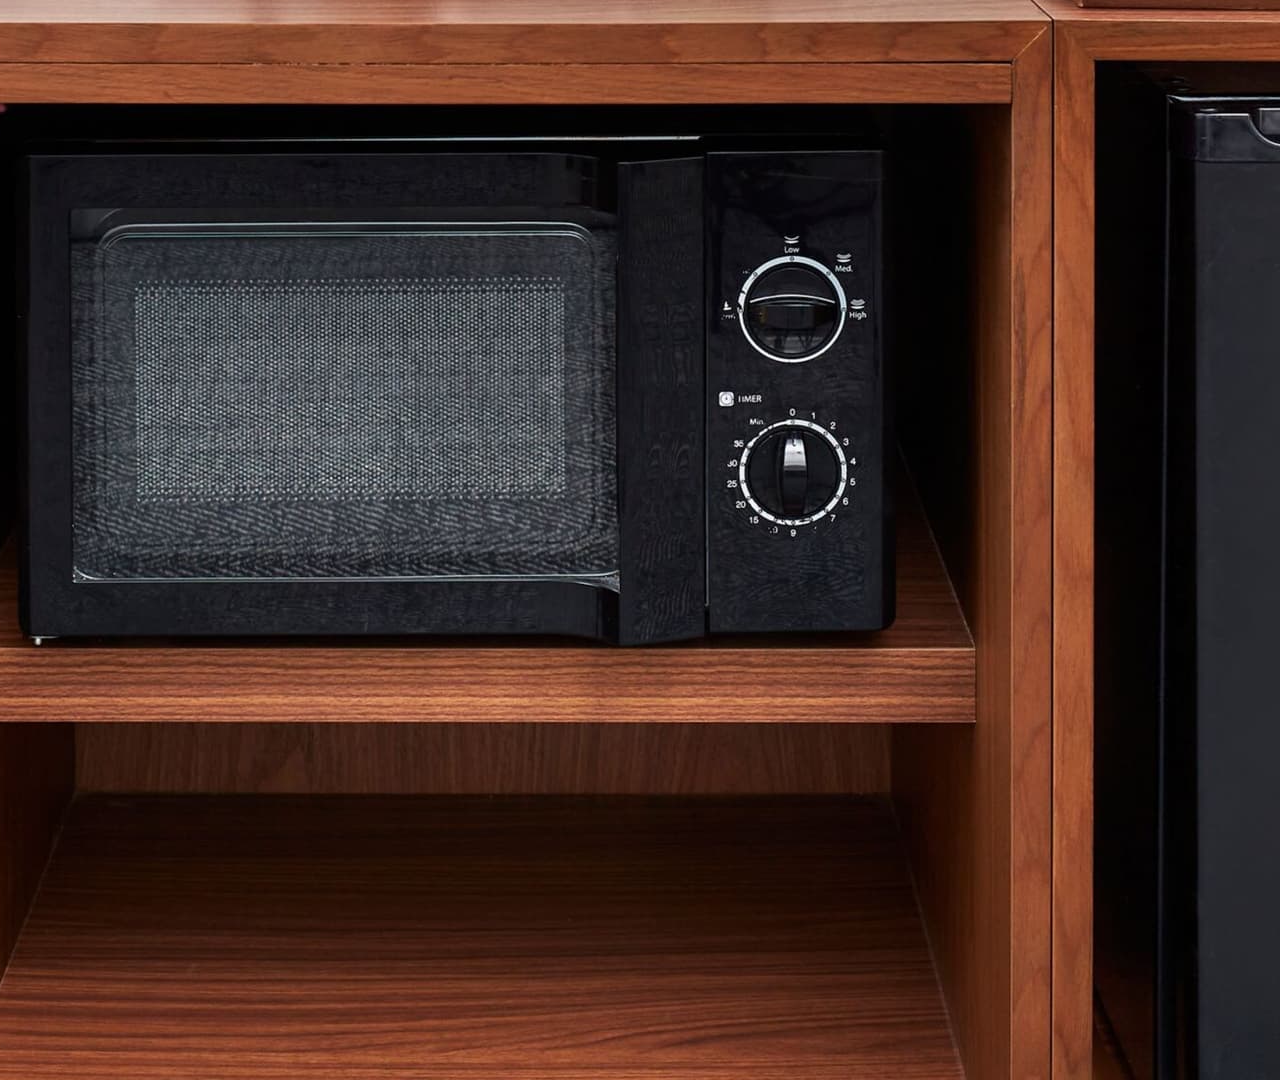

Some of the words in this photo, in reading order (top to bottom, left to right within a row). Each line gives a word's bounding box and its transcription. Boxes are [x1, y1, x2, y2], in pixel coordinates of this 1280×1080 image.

[784, 246, 800, 254] Low
[849, 311, 867, 320] High
[789, 408, 796, 416] 0
[812, 412, 817, 420] 1
[734, 440, 744, 448] 35
[843, 438, 850, 446] 3
[850, 457, 857, 465] 4
[727, 480, 738, 488] 25
[850, 478, 856, 486] 5
[736, 501, 746, 509] 20
[843, 497, 849, 505] 6
[749, 516, 759, 524] 15
[830, 514, 836, 522] 7
[790, 529, 797, 537] 9
